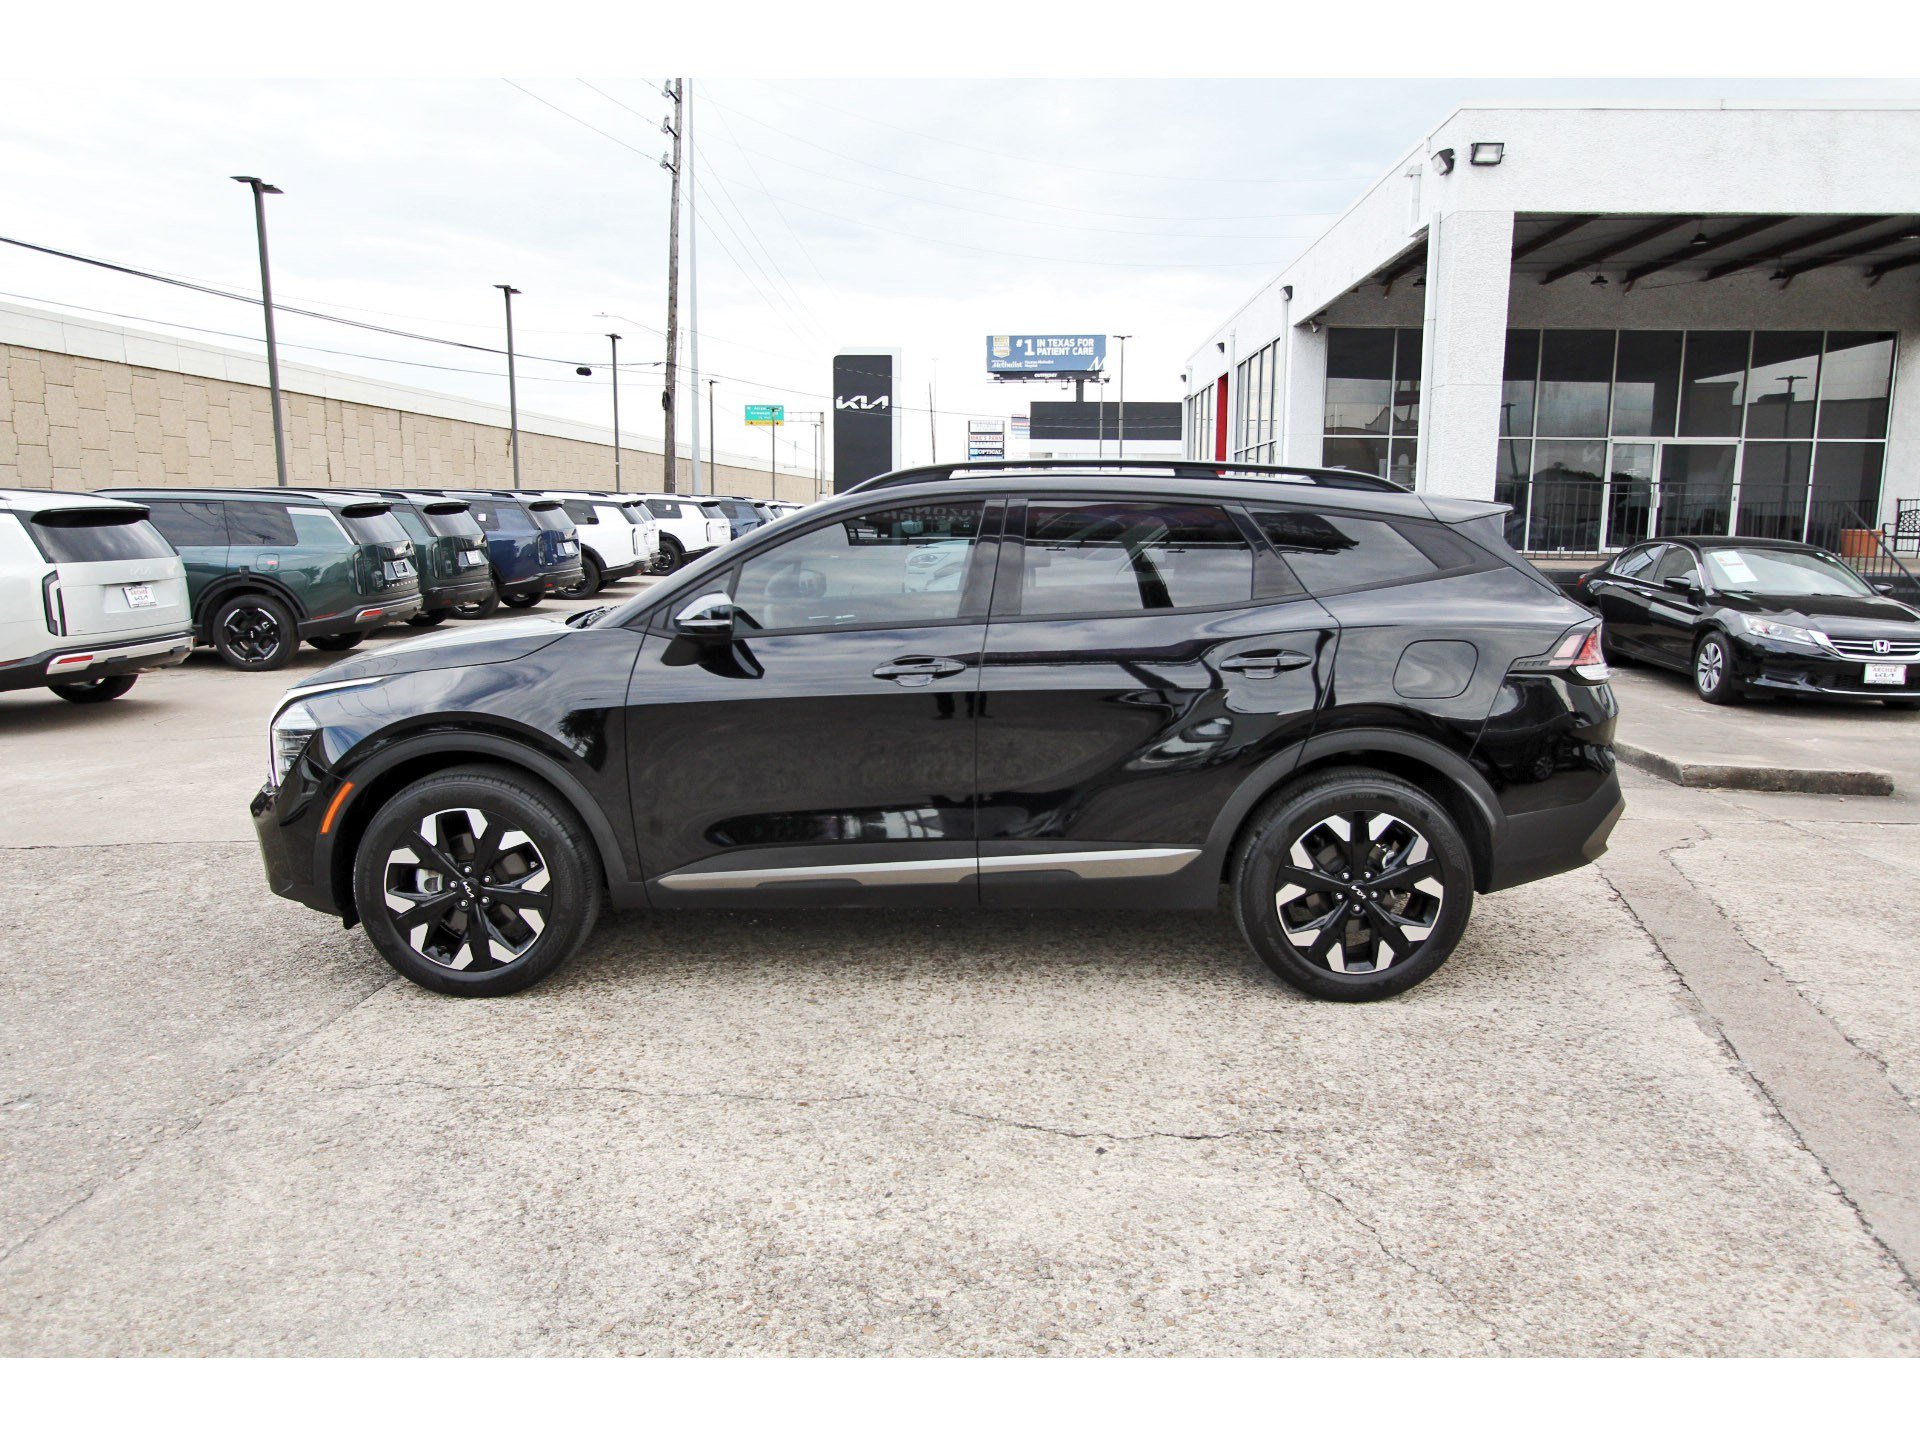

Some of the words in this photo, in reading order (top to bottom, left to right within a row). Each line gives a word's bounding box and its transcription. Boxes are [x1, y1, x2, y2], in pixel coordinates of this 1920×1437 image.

[1036, 338, 1046, 347] IN
[1047, 338, 1075, 347] TEXAS
[1077, 338, 1095, 347] FOR
[1036, 347, 1070, 356] PATIENT
[1072, 346, 1094, 356] CARE
